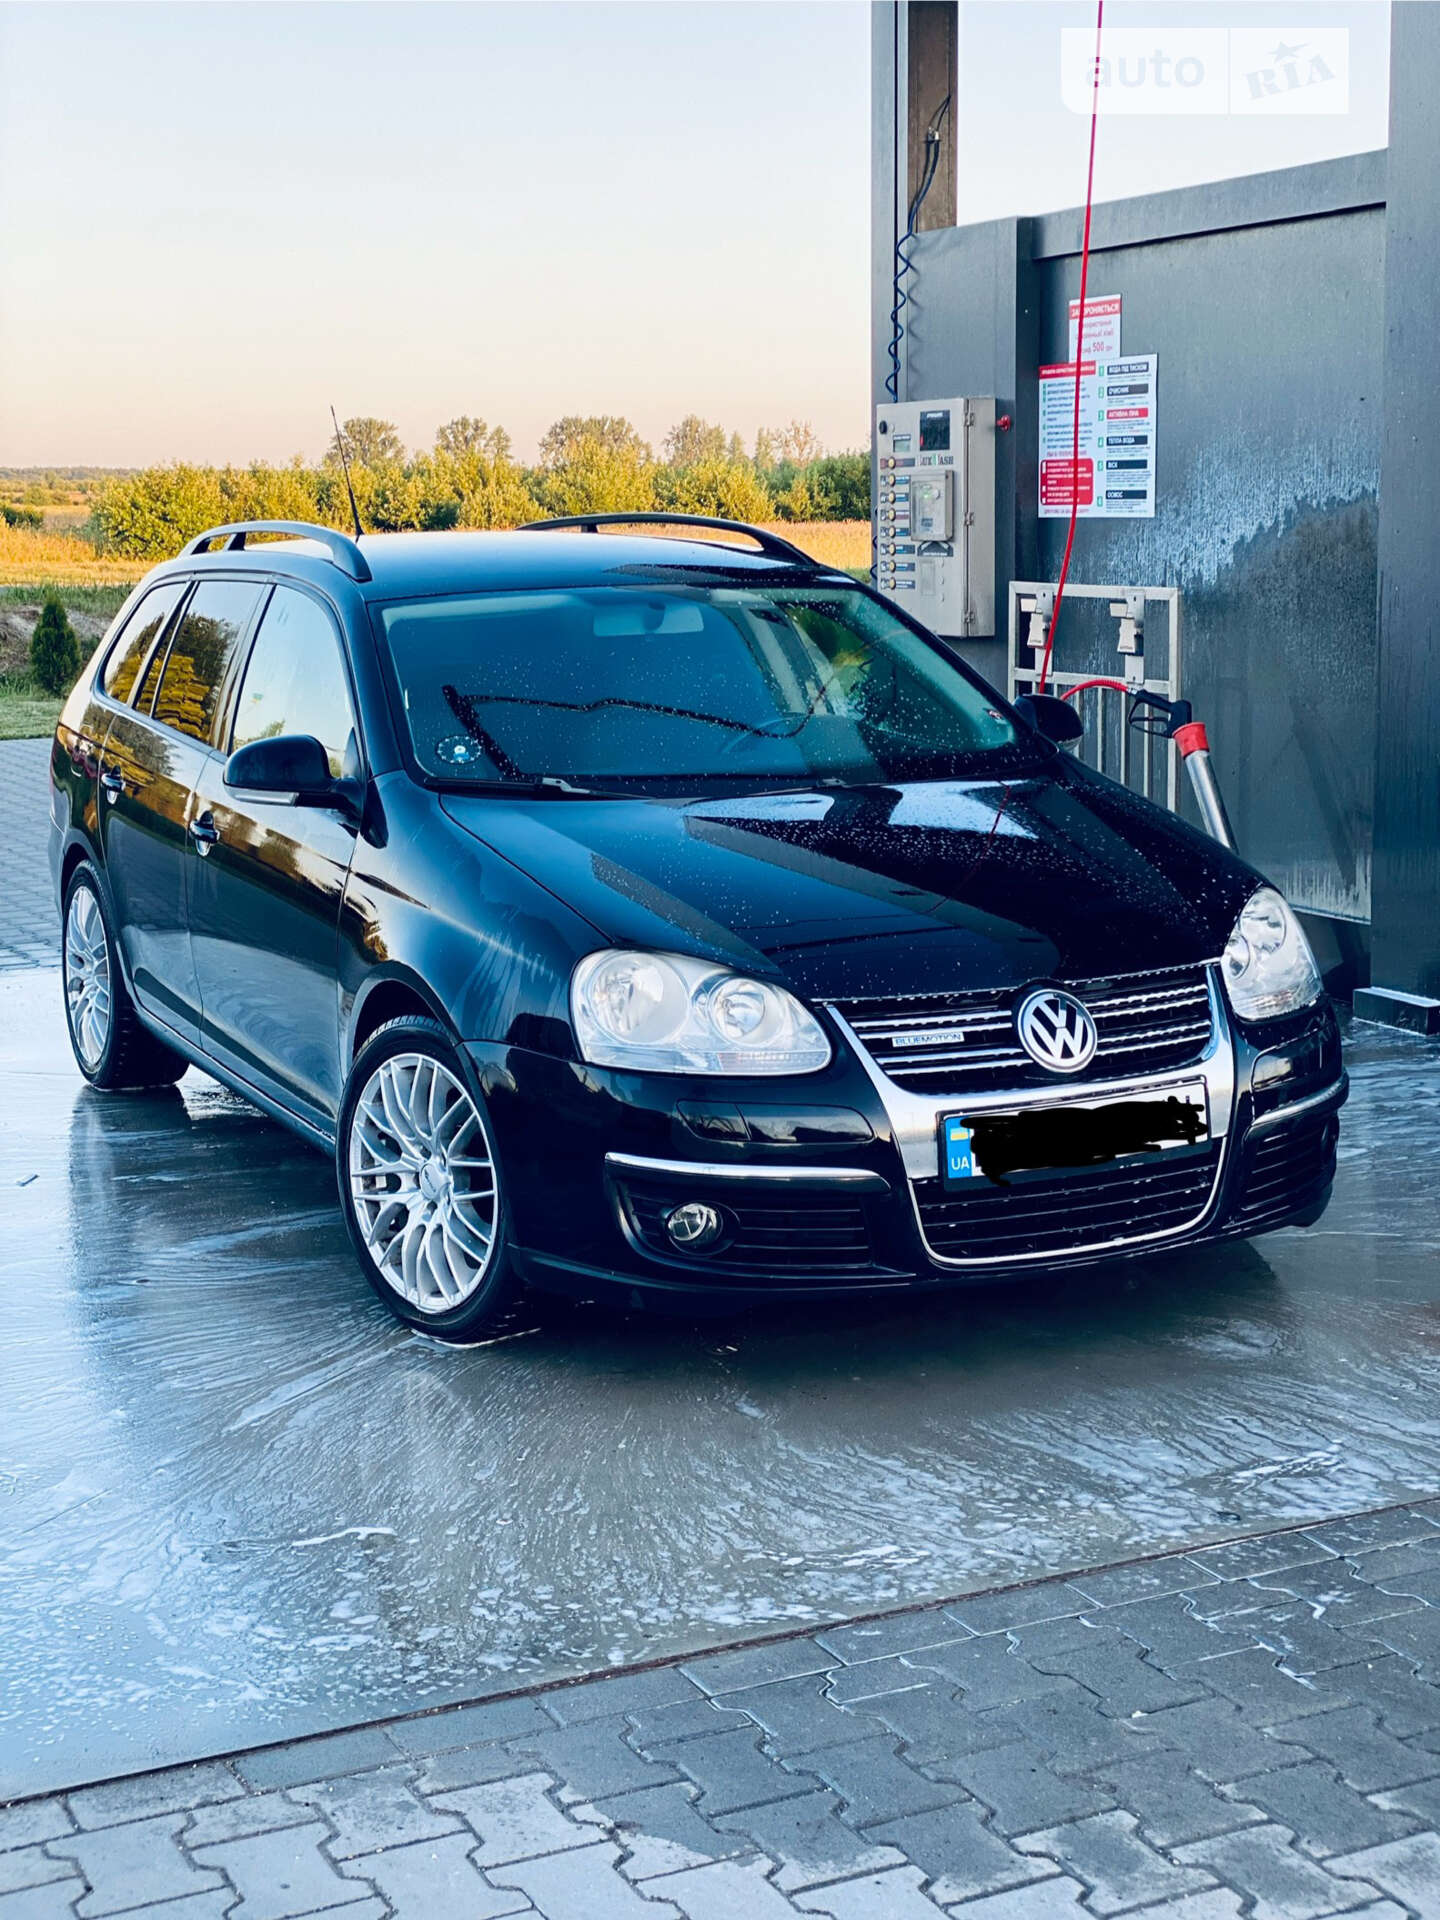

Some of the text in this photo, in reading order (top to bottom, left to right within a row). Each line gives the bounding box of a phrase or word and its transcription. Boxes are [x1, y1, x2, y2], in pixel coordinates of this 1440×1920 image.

[1093, 342, 1104, 352] 500
[894, 1033, 962, 1046] BLUEMOTION
[950, 1157, 970, 1170] UA
